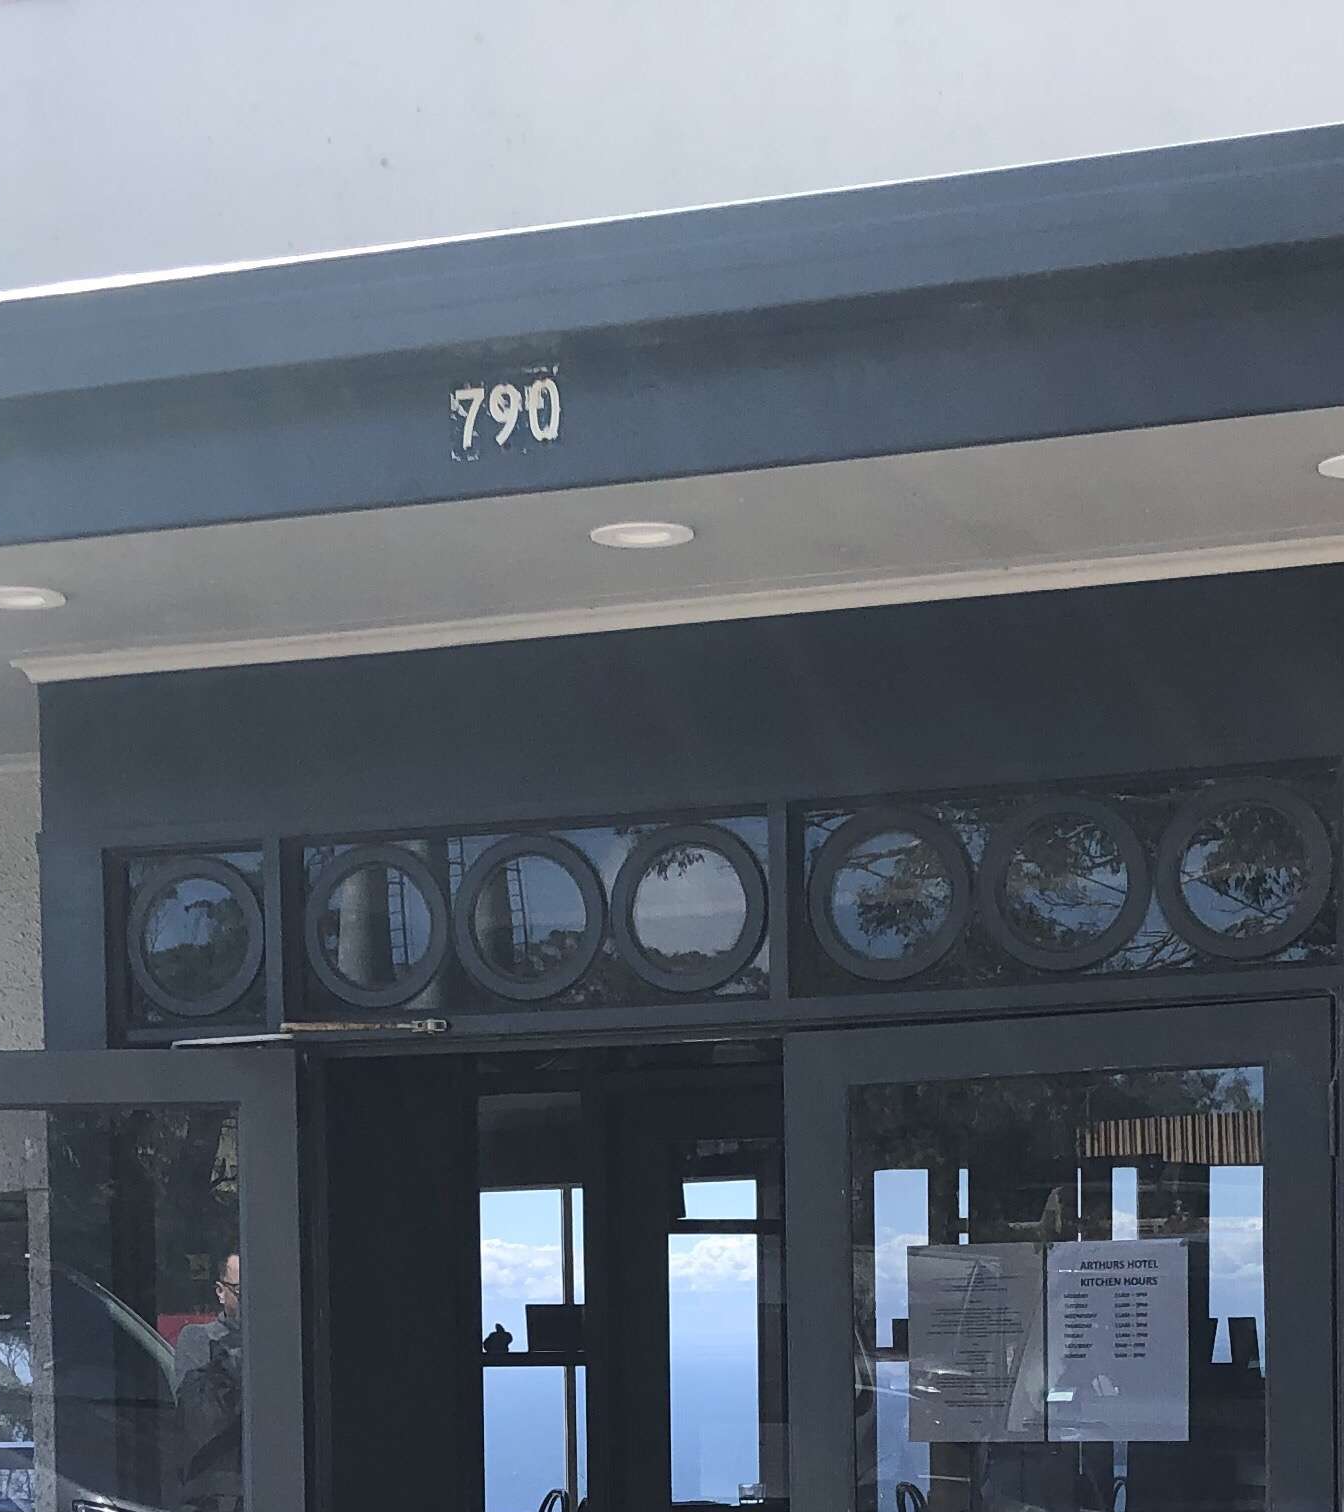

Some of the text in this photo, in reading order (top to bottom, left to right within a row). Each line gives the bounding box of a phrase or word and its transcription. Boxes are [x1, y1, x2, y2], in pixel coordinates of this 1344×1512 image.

[455, 378, 560, 450] 790
[1080, 1259, 1159, 1271] ARTHURS HOTEL
[1080, 1276, 1158, 1288] KITCHEN HOURS
